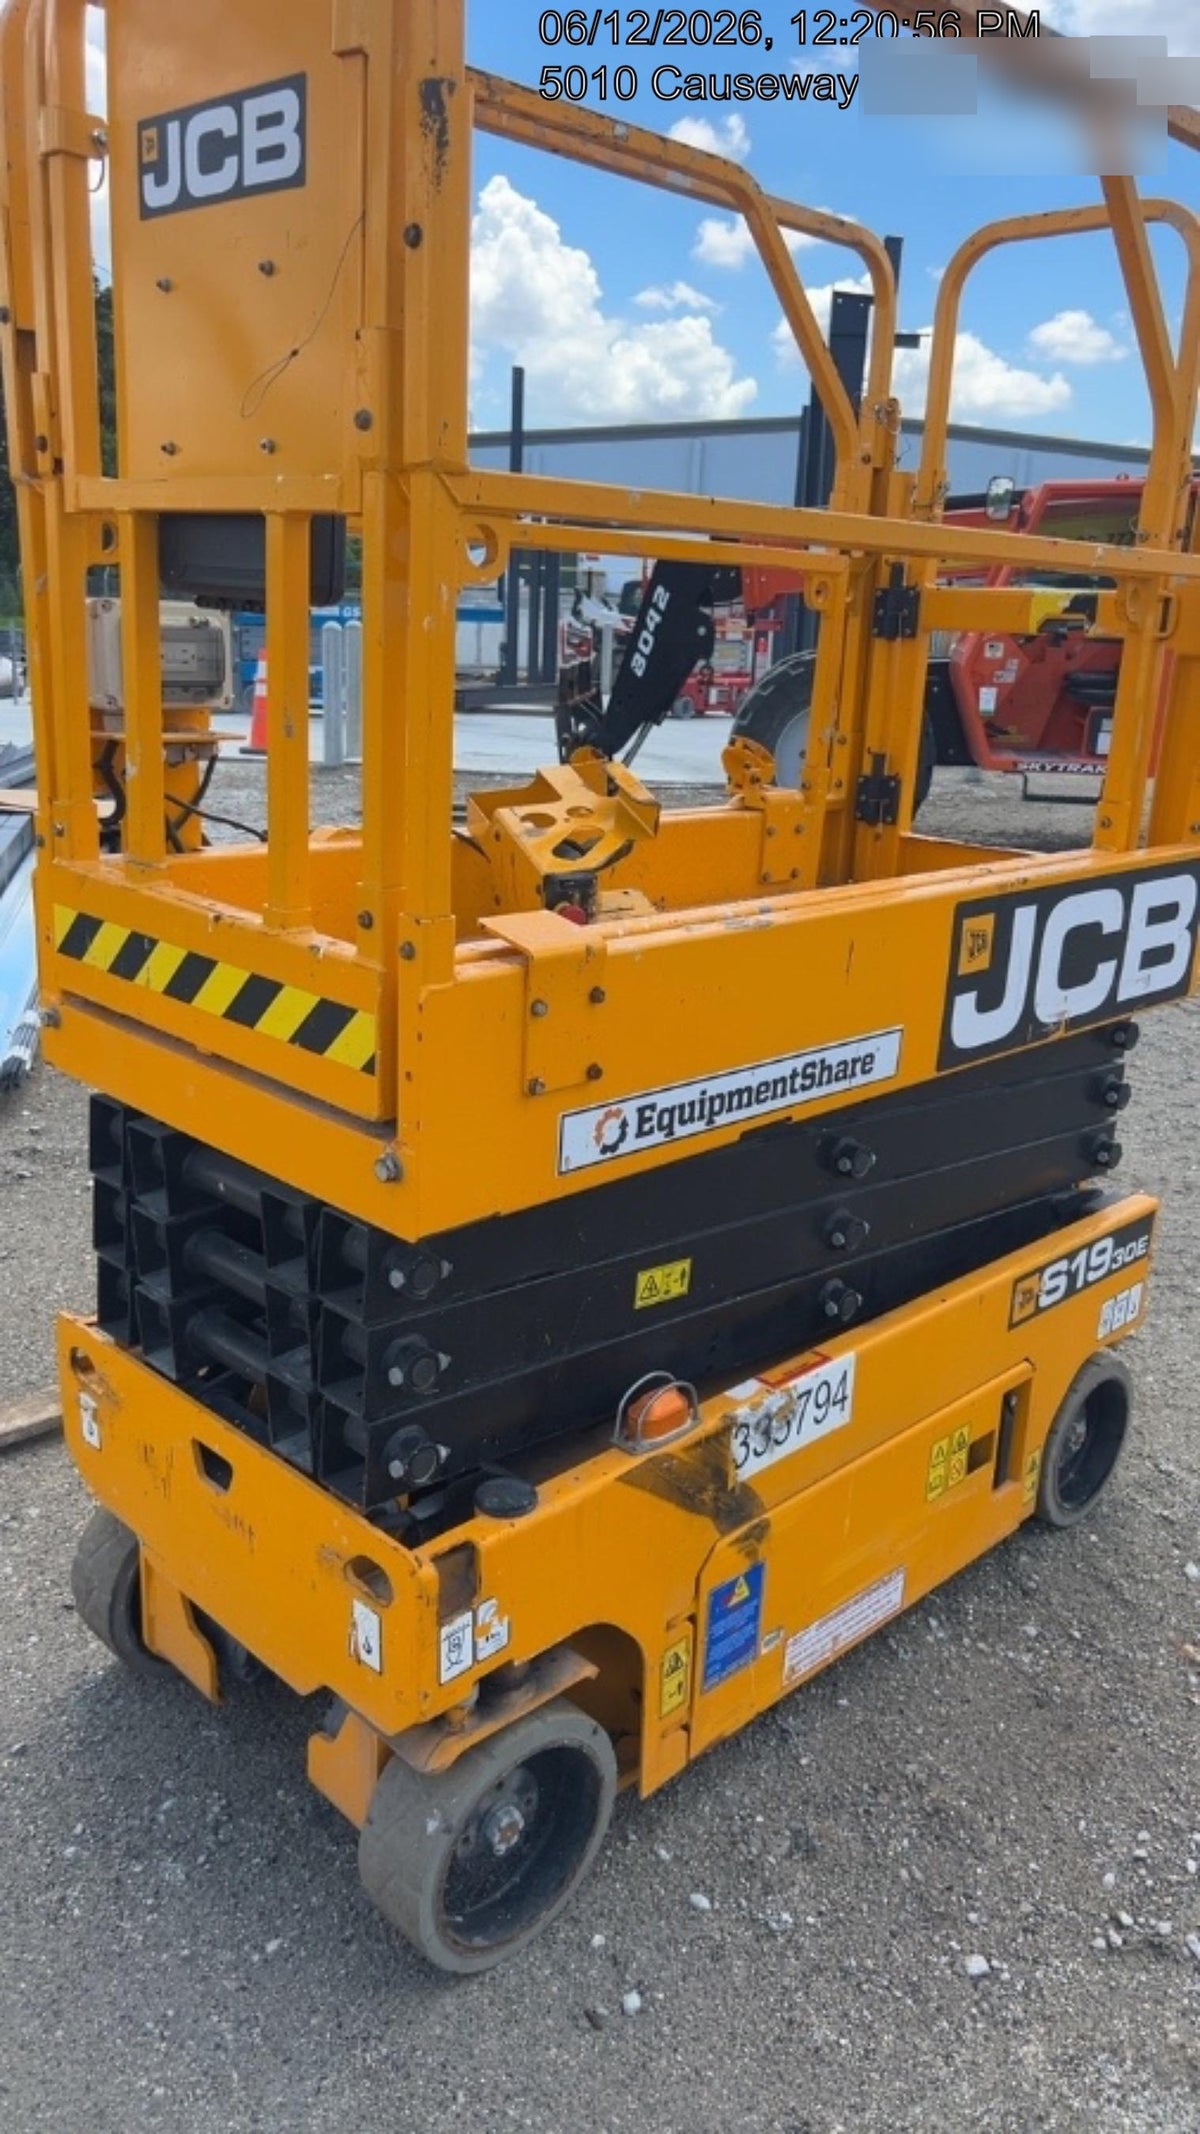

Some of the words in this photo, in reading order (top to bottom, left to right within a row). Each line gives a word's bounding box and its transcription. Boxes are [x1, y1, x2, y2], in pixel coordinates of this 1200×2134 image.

[142, 88, 301, 208] JCB
[630, 584, 670, 678] 8042
[951, 873, 1198, 1050] JCB
[634, 1051, 877, 1139] EquipmentShare
